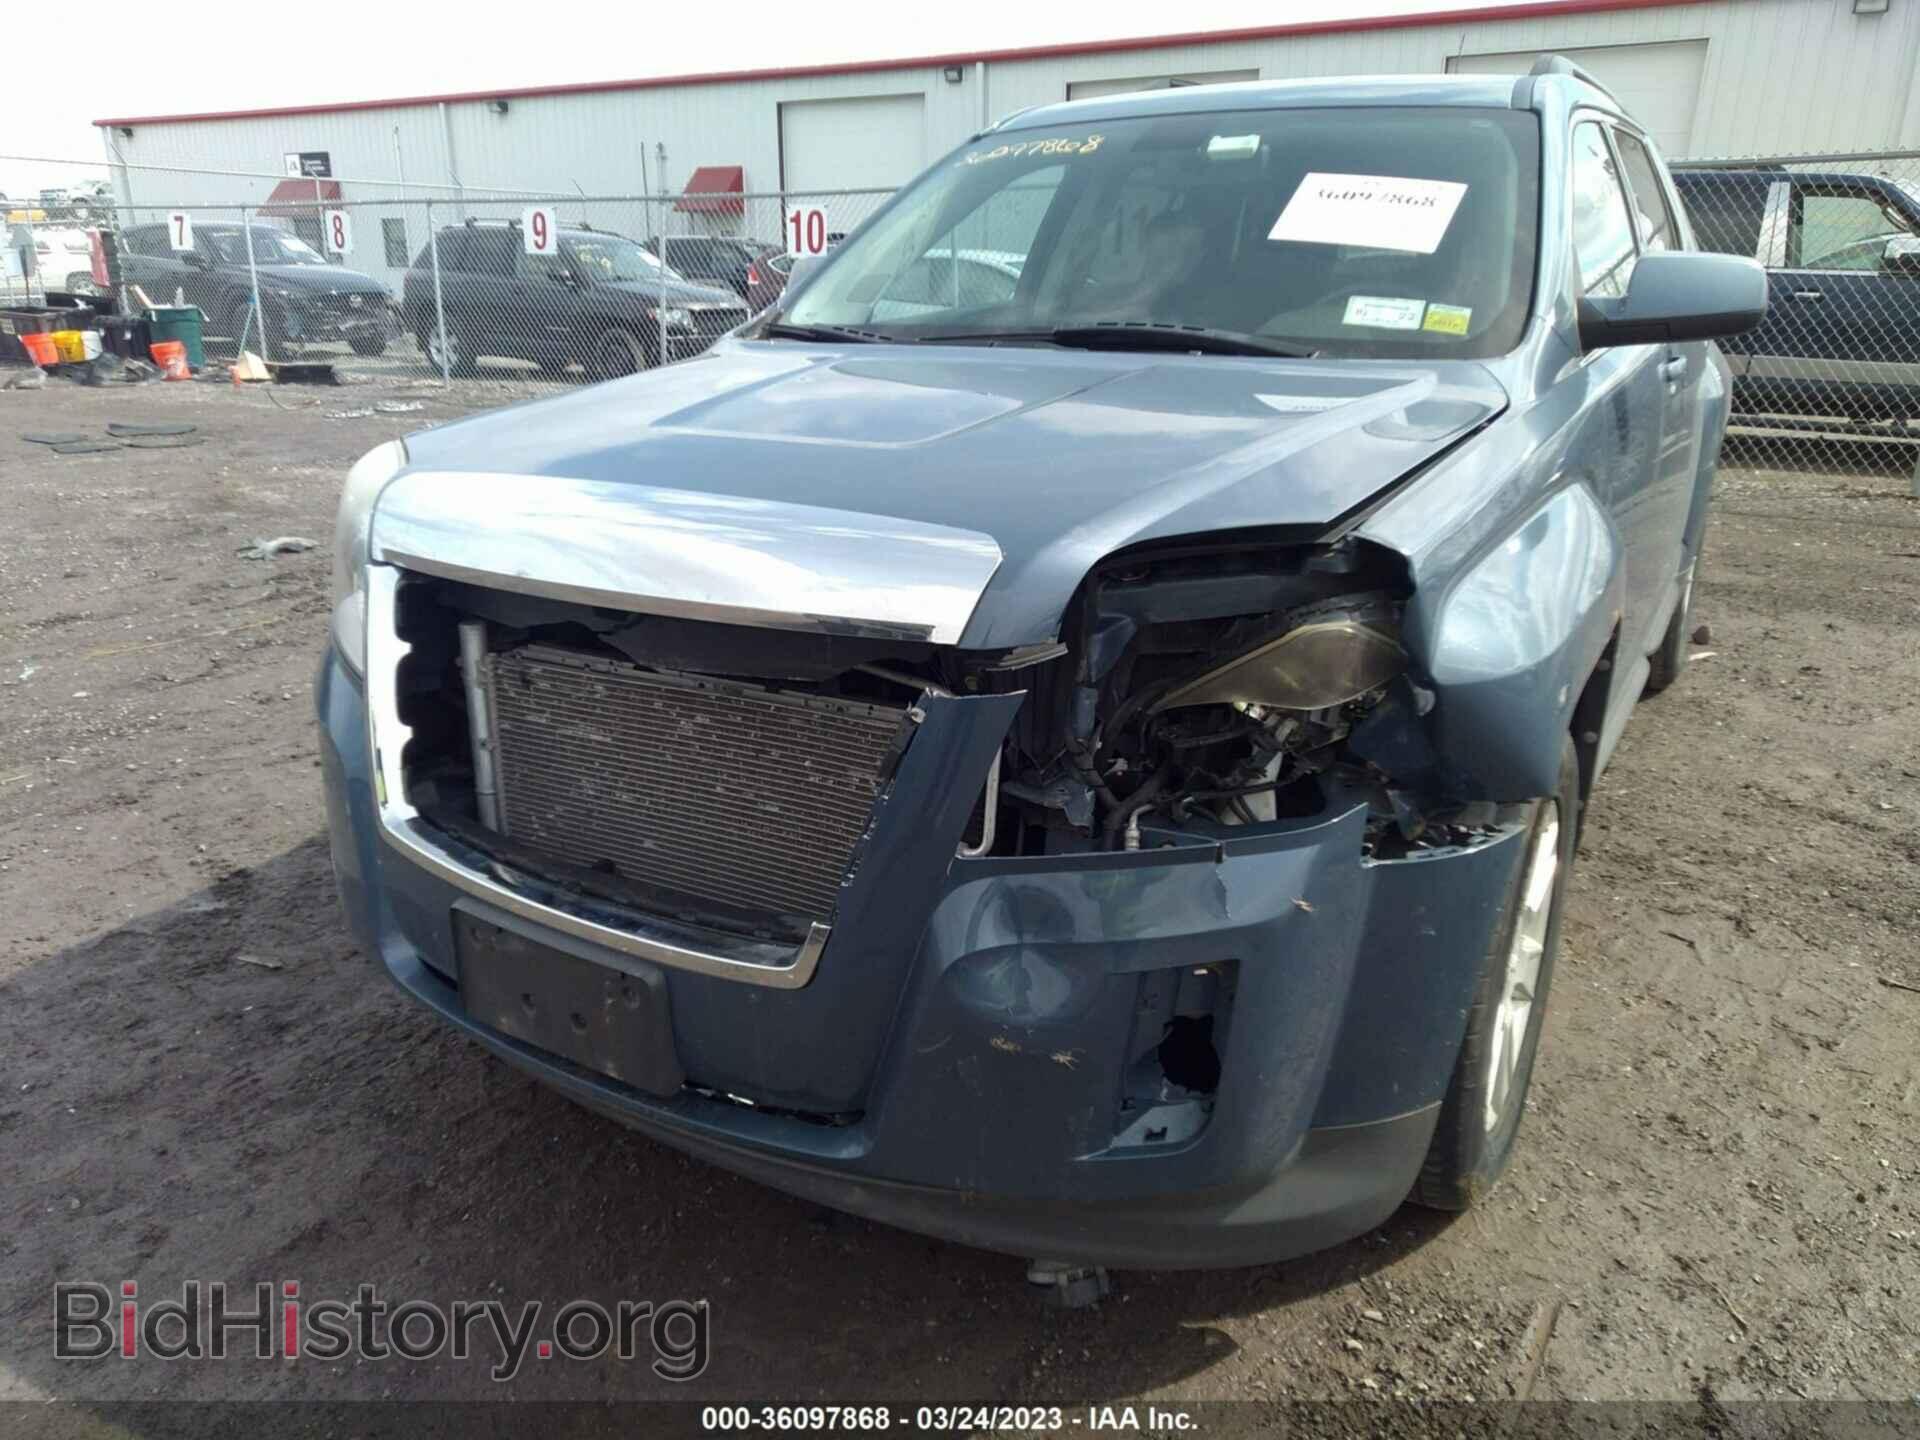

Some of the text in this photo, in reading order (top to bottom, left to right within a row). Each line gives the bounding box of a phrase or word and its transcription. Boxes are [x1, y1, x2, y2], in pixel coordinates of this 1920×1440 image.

[173, 215, 185, 246] 7
[333, 214, 345, 249] 8
[532, 211, 547, 250] 9
[789, 209, 825, 255] 10
